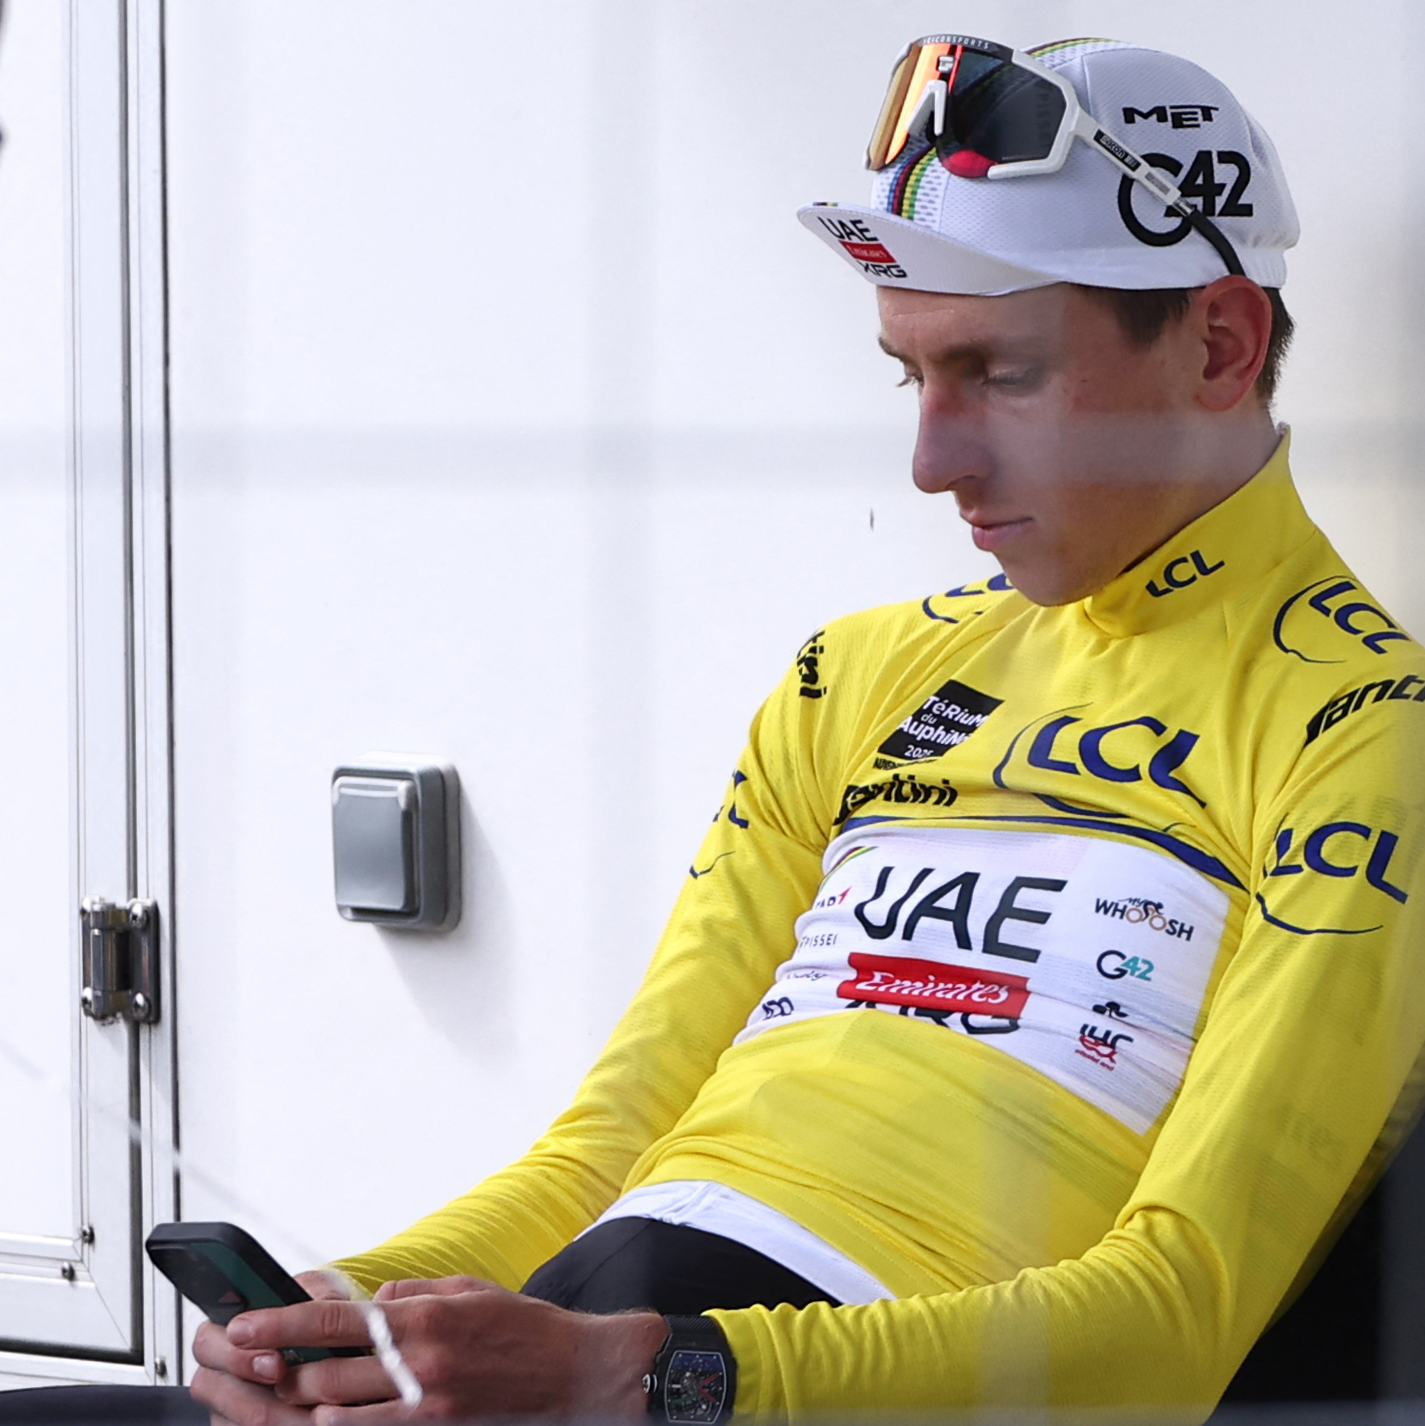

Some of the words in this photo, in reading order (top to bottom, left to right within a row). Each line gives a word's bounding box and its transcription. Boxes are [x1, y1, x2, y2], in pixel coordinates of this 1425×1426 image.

[1122, 104, 1219, 129] MET
[1117, 150, 1253, 247] G42
[817, 216, 879, 242] UAE
[855, 260, 908, 278] XRG
[1145, 549, 1226, 598] LCL
[1308, 580, 1413, 655] LCL
[1027, 715, 1208, 810] LCL
[1269, 820, 1409, 905] LCL
[853, 866, 1069, 964] UAE
[855, 970, 1010, 1004] Emirates
[1096, 949, 1155, 982] G42
